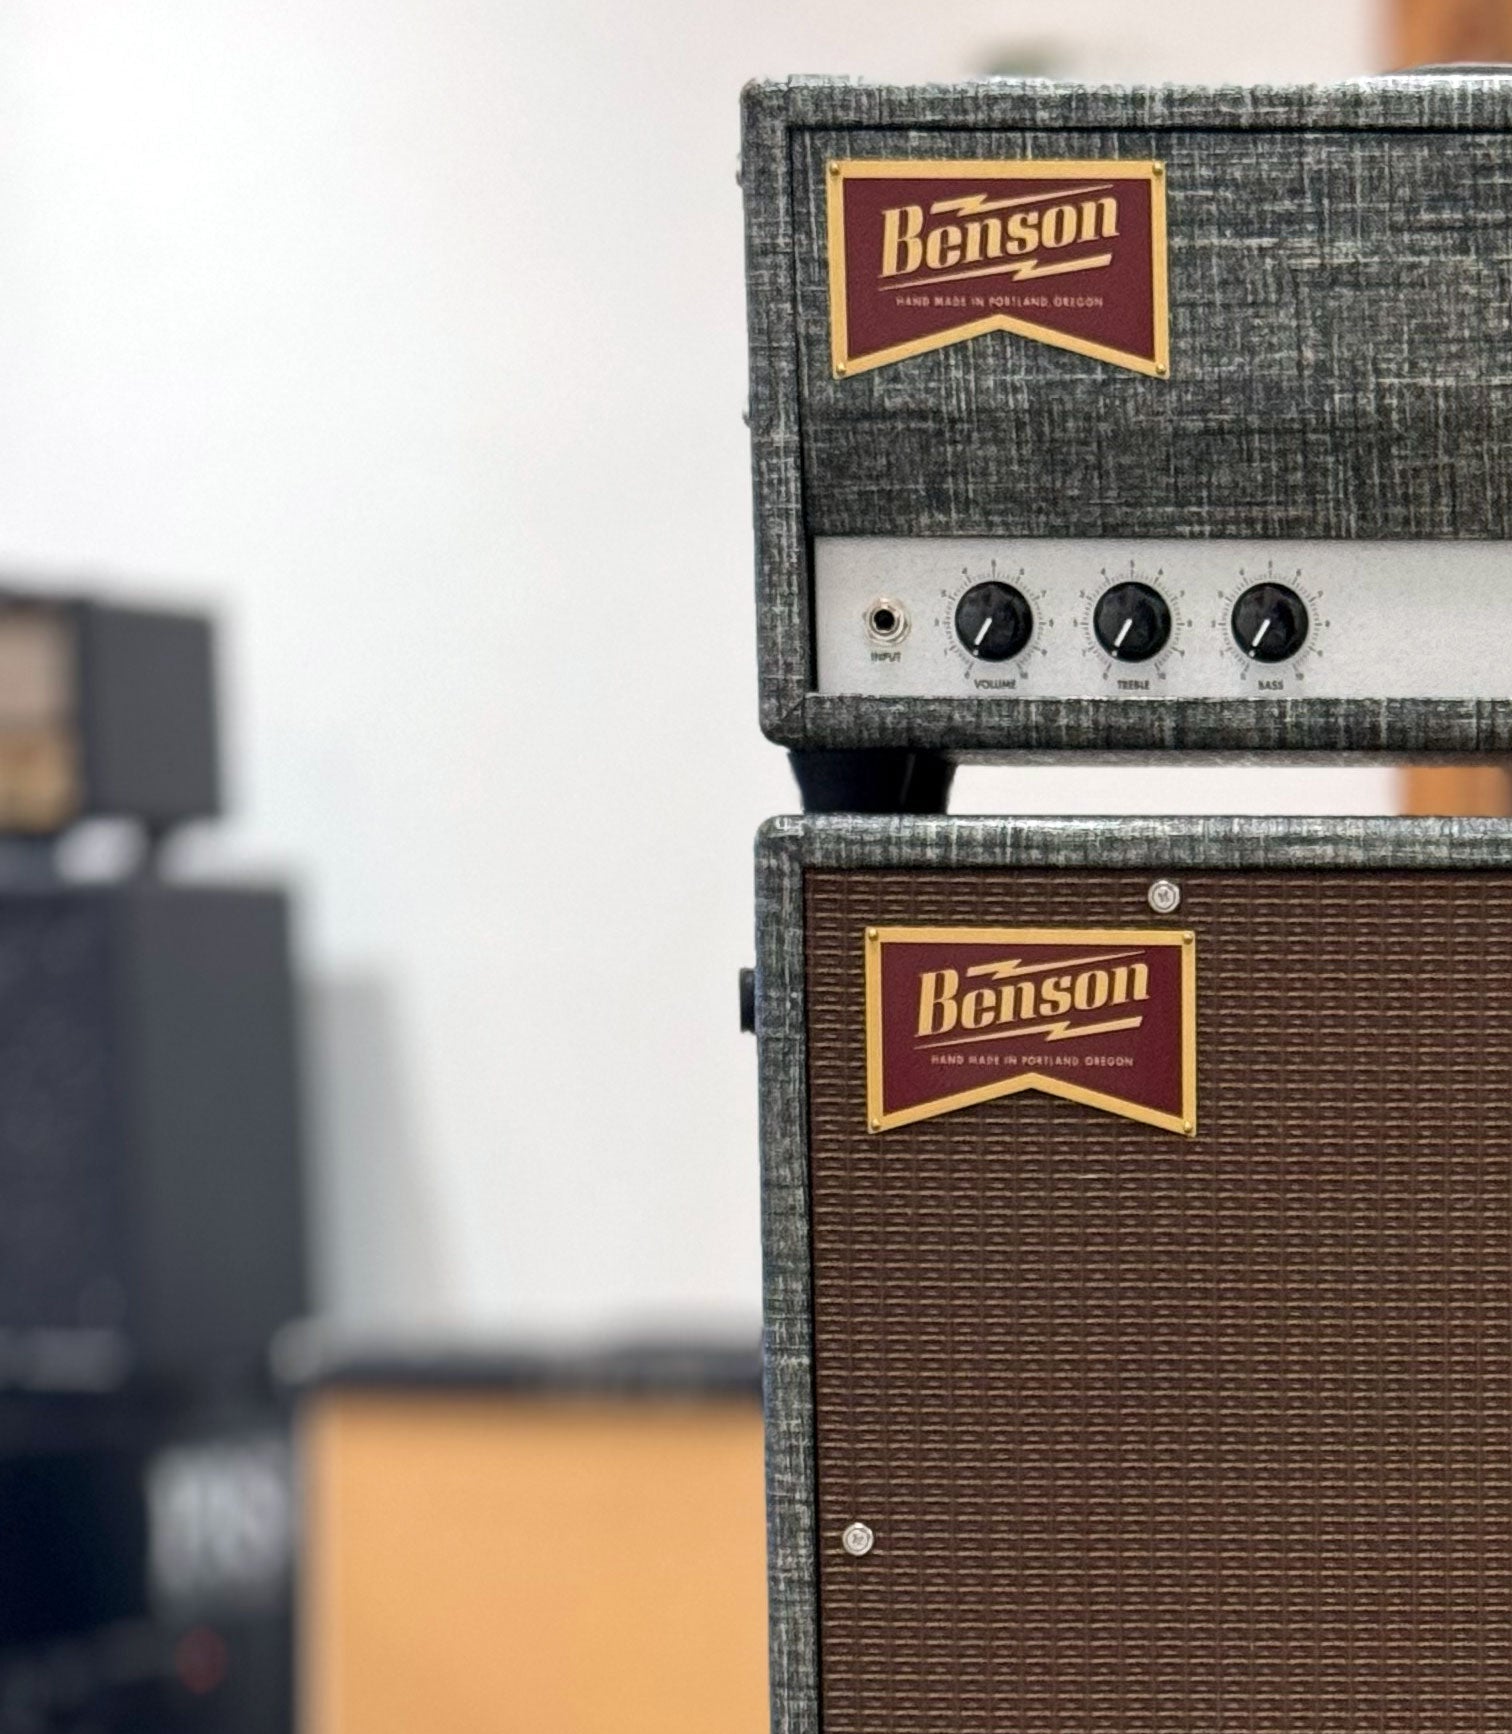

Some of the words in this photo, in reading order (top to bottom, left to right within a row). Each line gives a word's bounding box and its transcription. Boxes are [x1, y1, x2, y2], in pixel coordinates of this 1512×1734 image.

[878, 196, 1119, 278] Benson
[896, 295, 930, 307] HAND
[934, 295, 967, 307] MADE
[972, 296, 985, 307] IN
[870, 651, 902, 662] INPUT
[974, 679, 1016, 689] VOLUME
[1117, 680, 1150, 690] TREBLE
[1258, 681, 1284, 690] BASS
[914, 963, 1150, 1037] Benson
[931, 1055, 964, 1065] HAND
[968, 1055, 999, 1066] MADE
[1004, 1055, 1017, 1066] IN
[1084, 1056, 1134, 1067] OREGON
